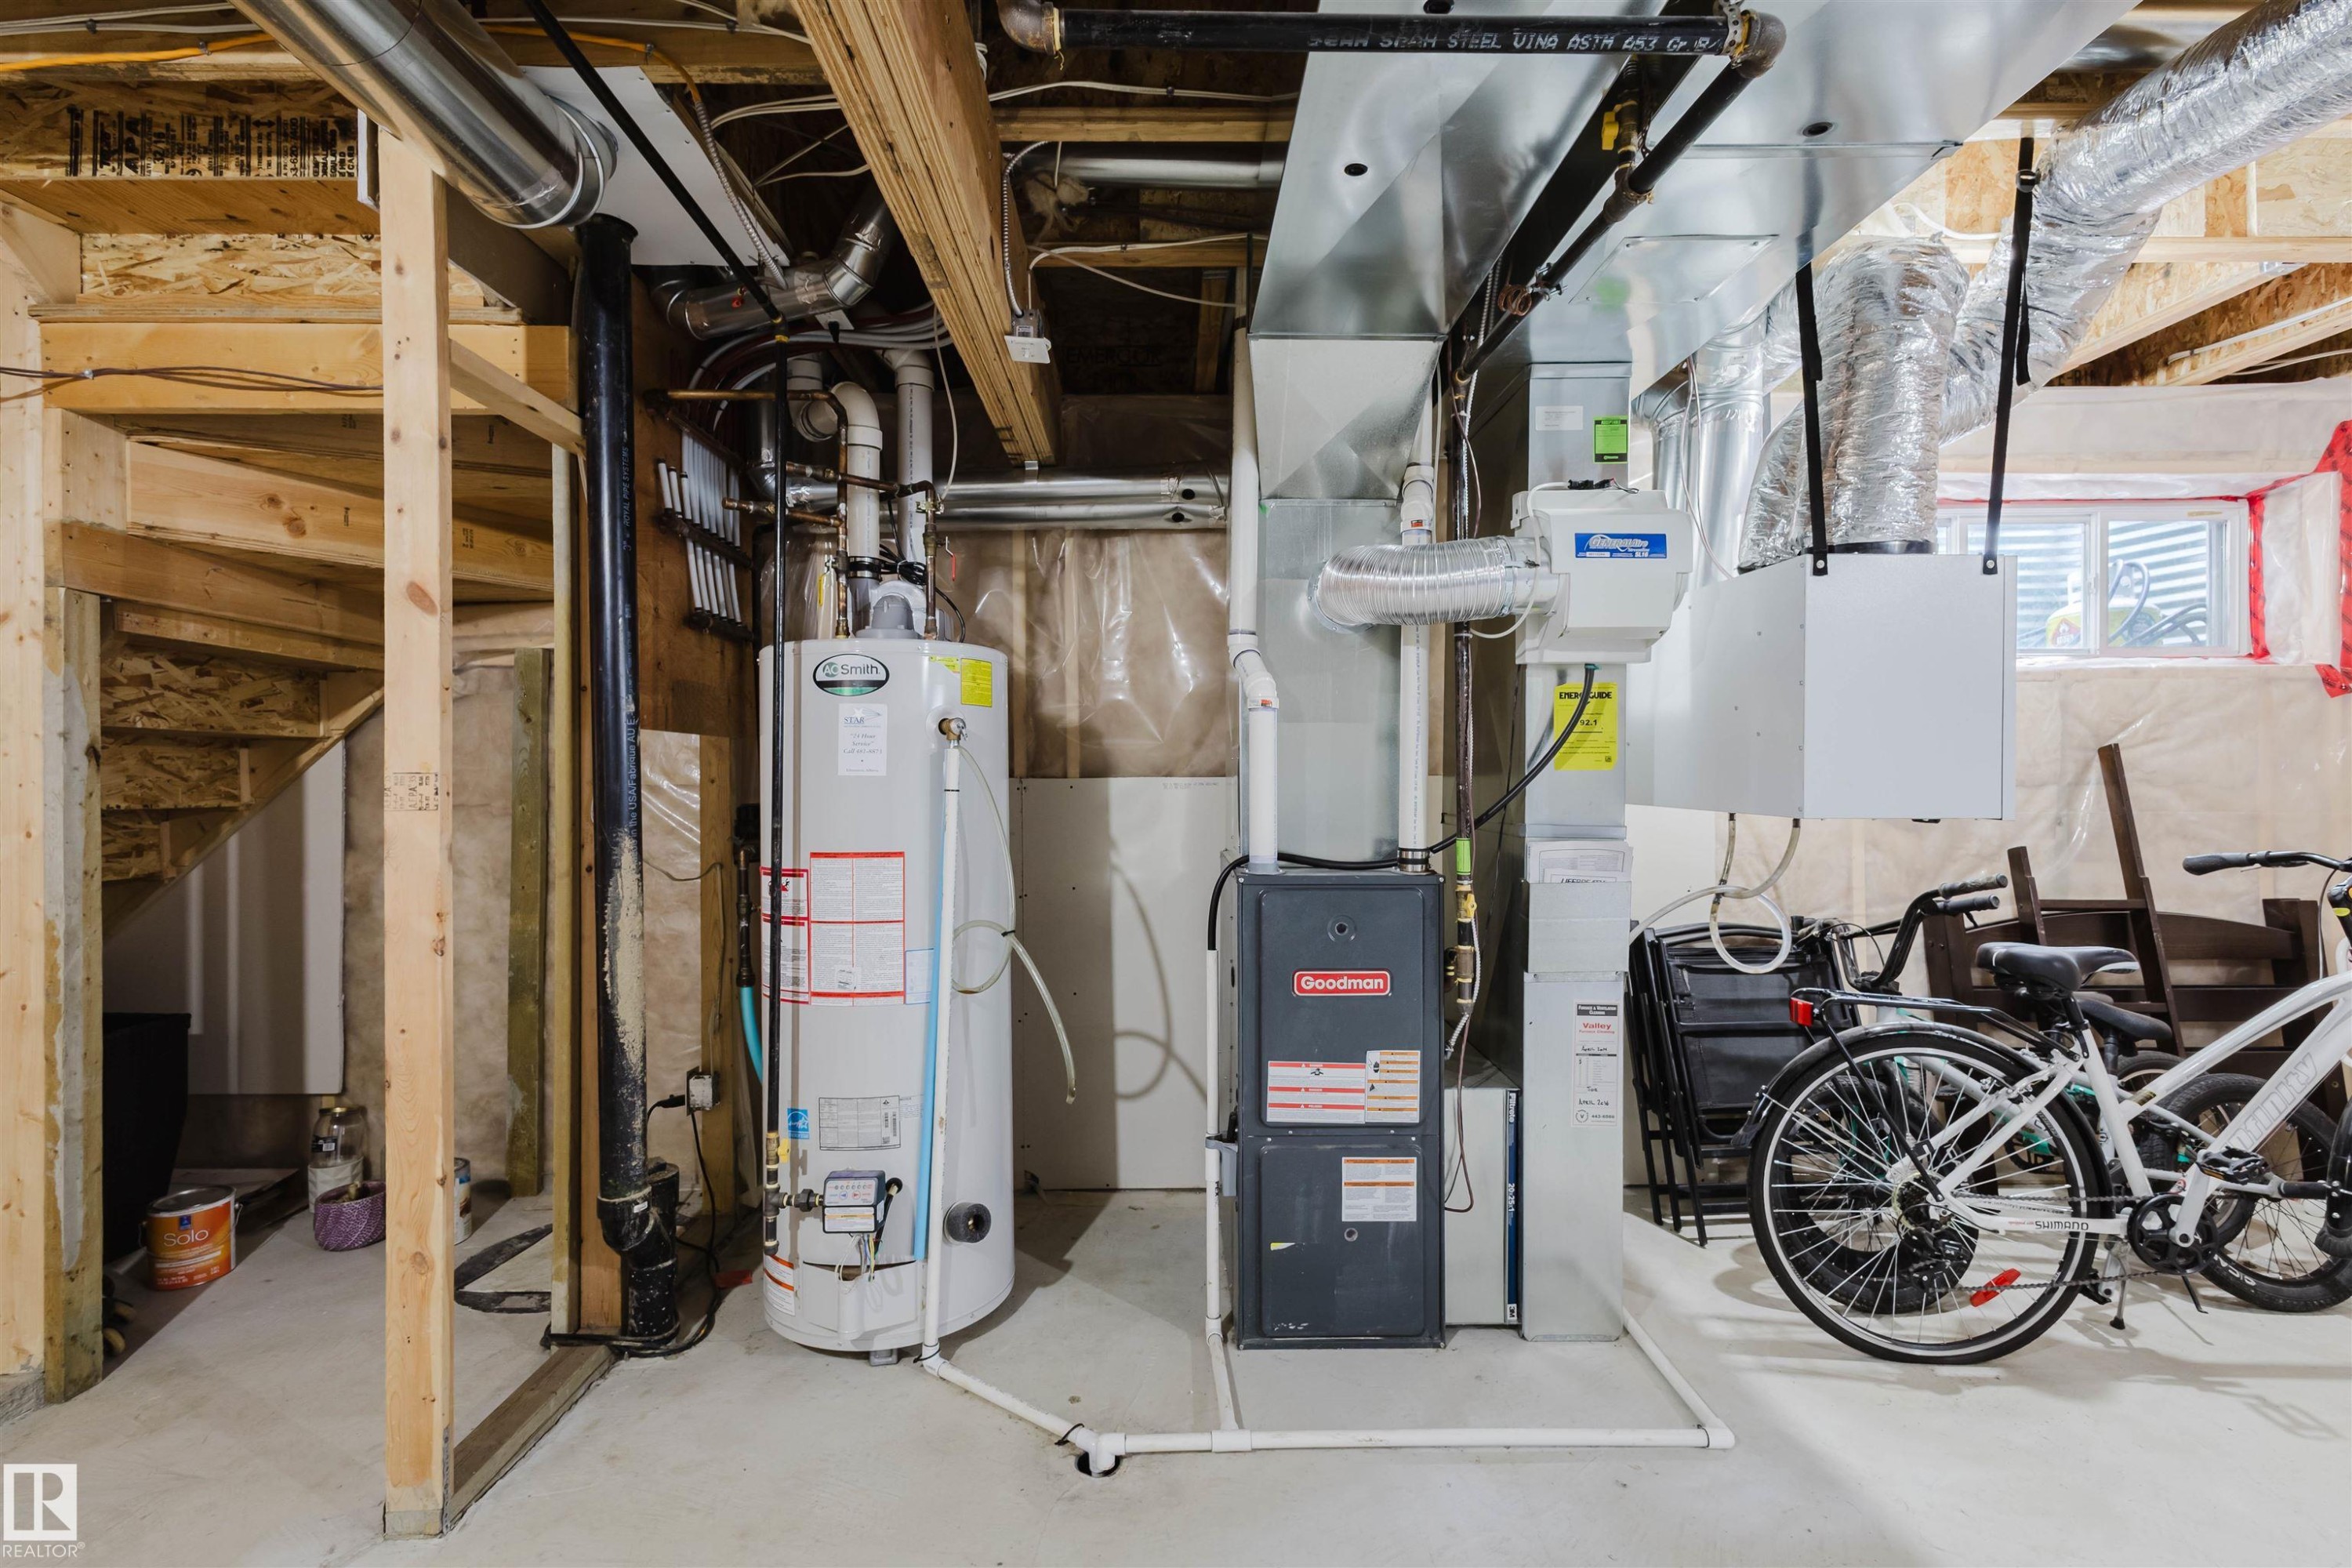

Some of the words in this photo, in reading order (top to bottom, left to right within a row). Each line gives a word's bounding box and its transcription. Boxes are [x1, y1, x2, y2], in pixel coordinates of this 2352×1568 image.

[1447, 31, 1502, 49] STEEL
[1567, 33, 1617, 50] ASTM
[124, 118, 140, 173] APA
[628, 812, 637, 827] the
[1301, 976, 1384, 990] Goodman
[2035, 1221, 2089, 1231] SHIMANO
[163, 1229, 209, 1247] Solo
[1508, 1305, 1515, 1318] 3M
